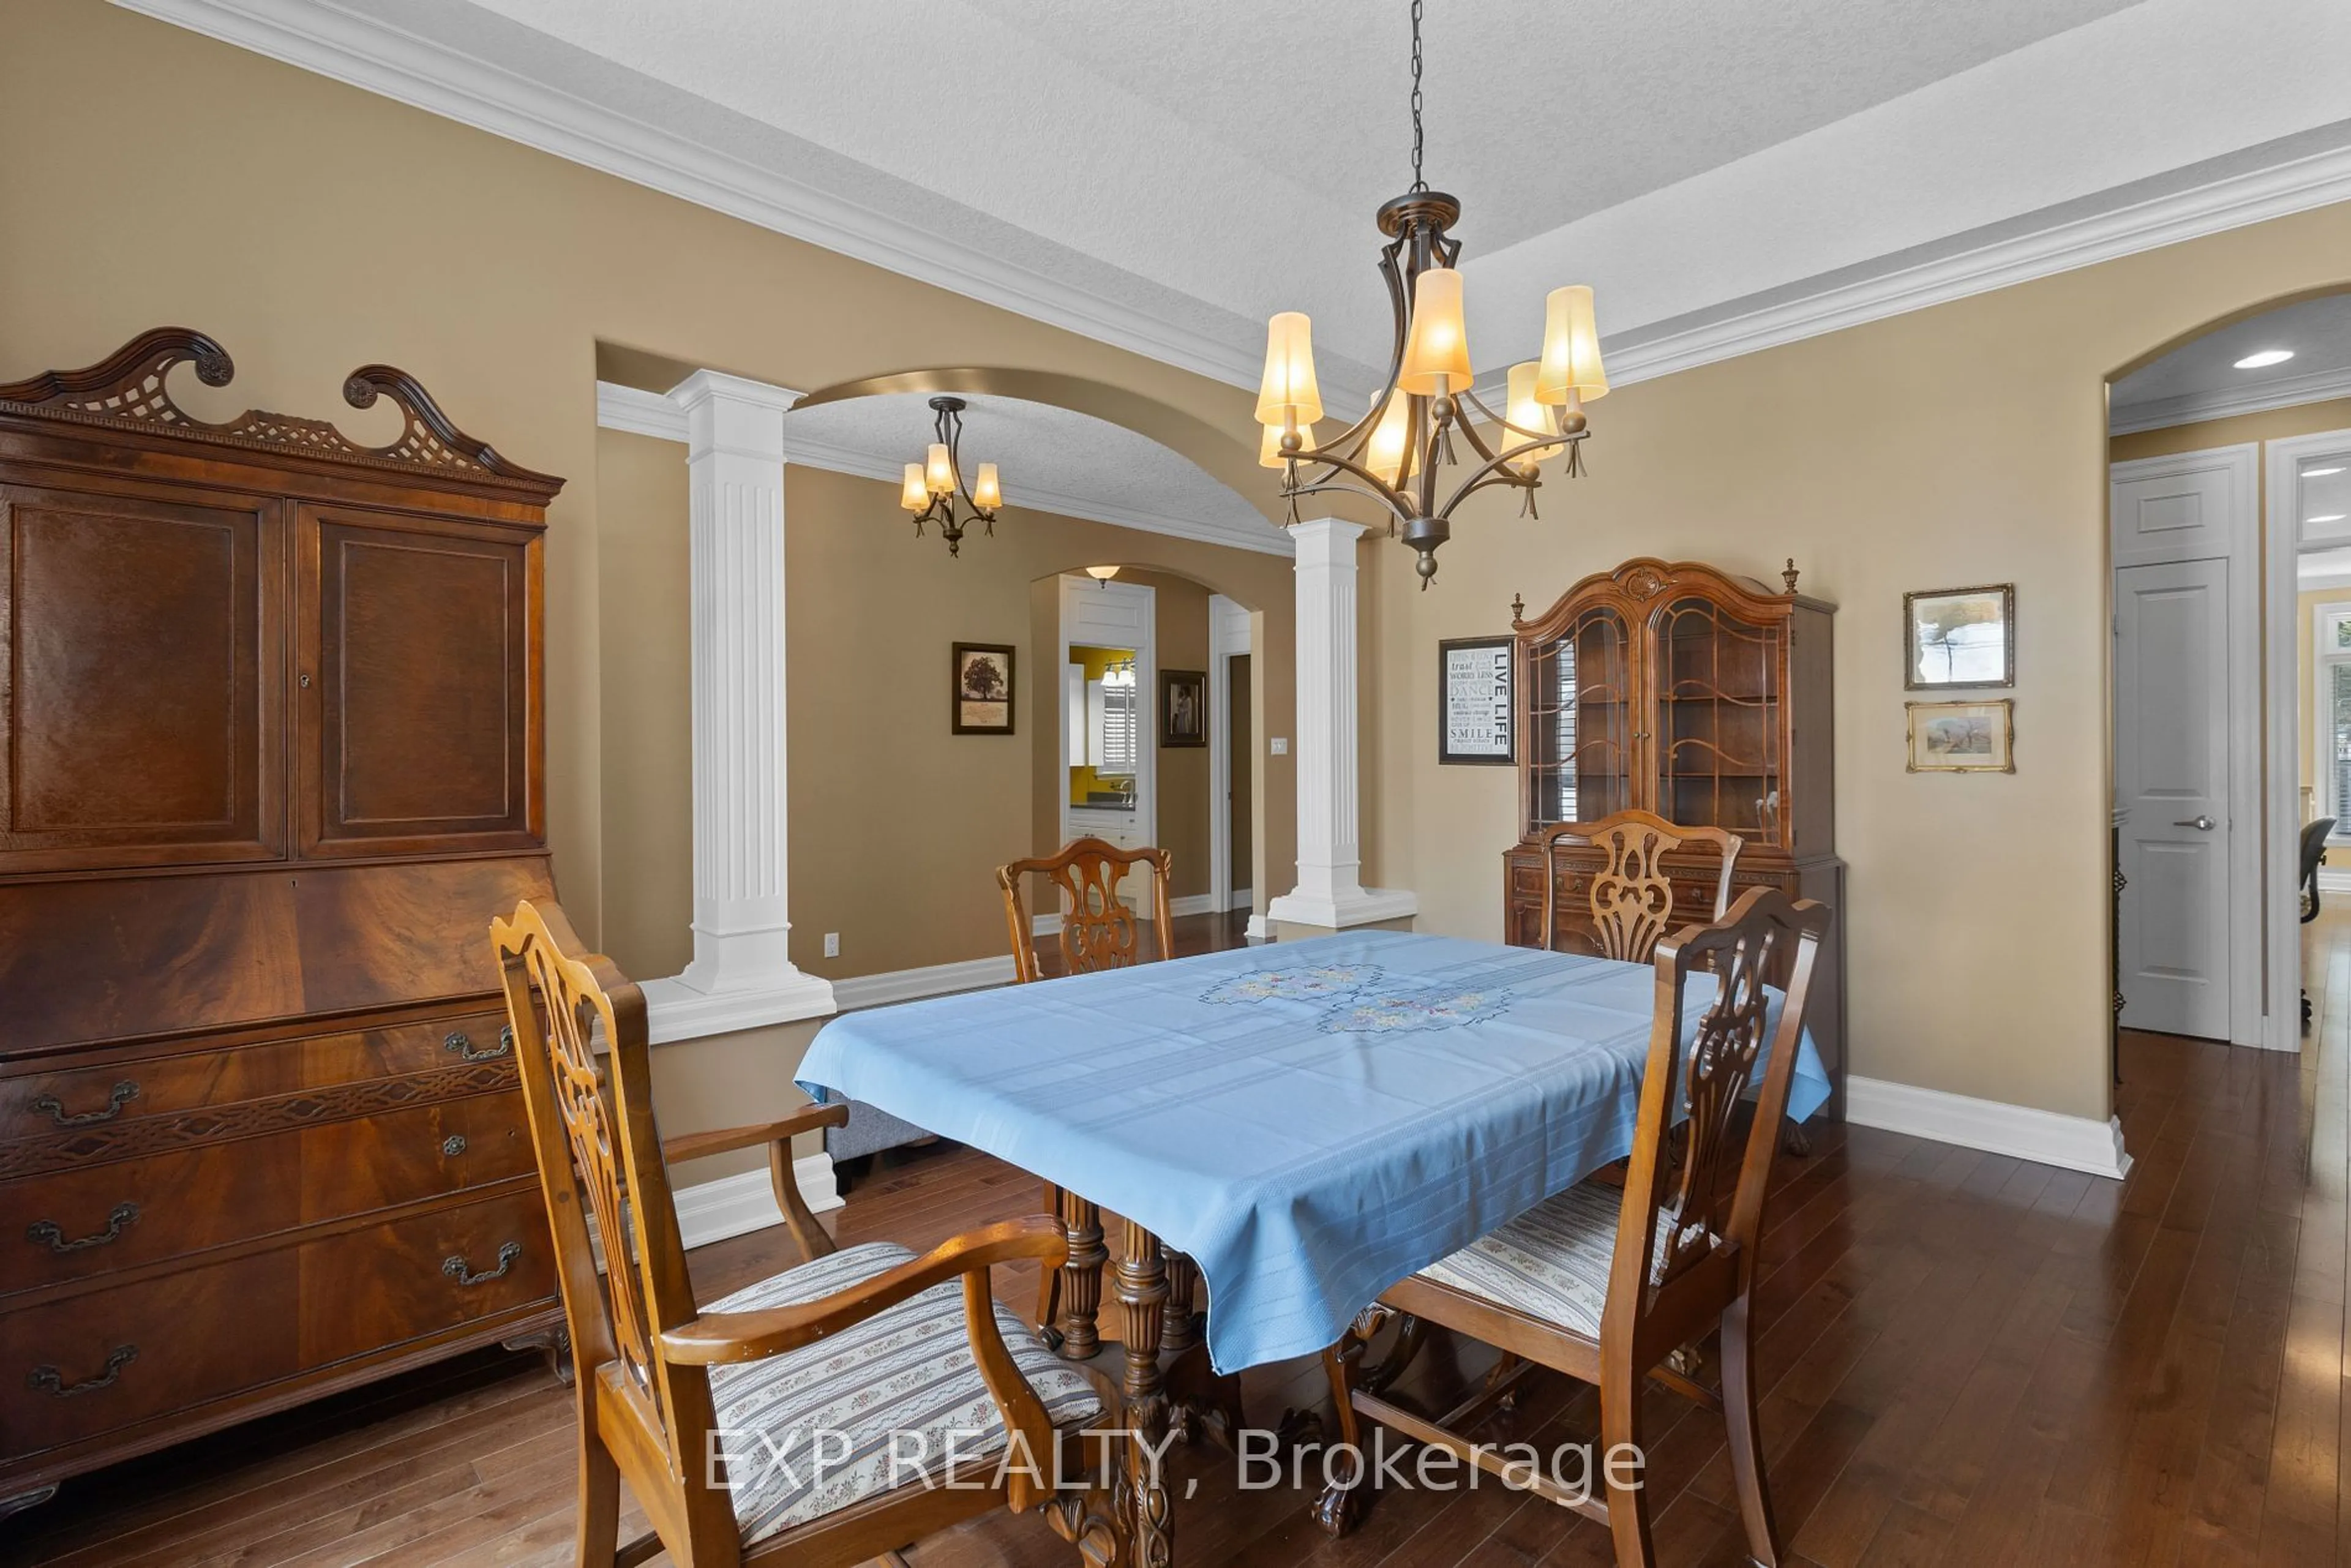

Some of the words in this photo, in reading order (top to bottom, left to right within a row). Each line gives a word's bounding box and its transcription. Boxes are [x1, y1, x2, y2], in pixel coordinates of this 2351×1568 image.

[1494, 654, 1507, 696] LIVE
[1450, 729, 1493, 738] SMILE
[1494, 704, 1507, 745] LIFE
